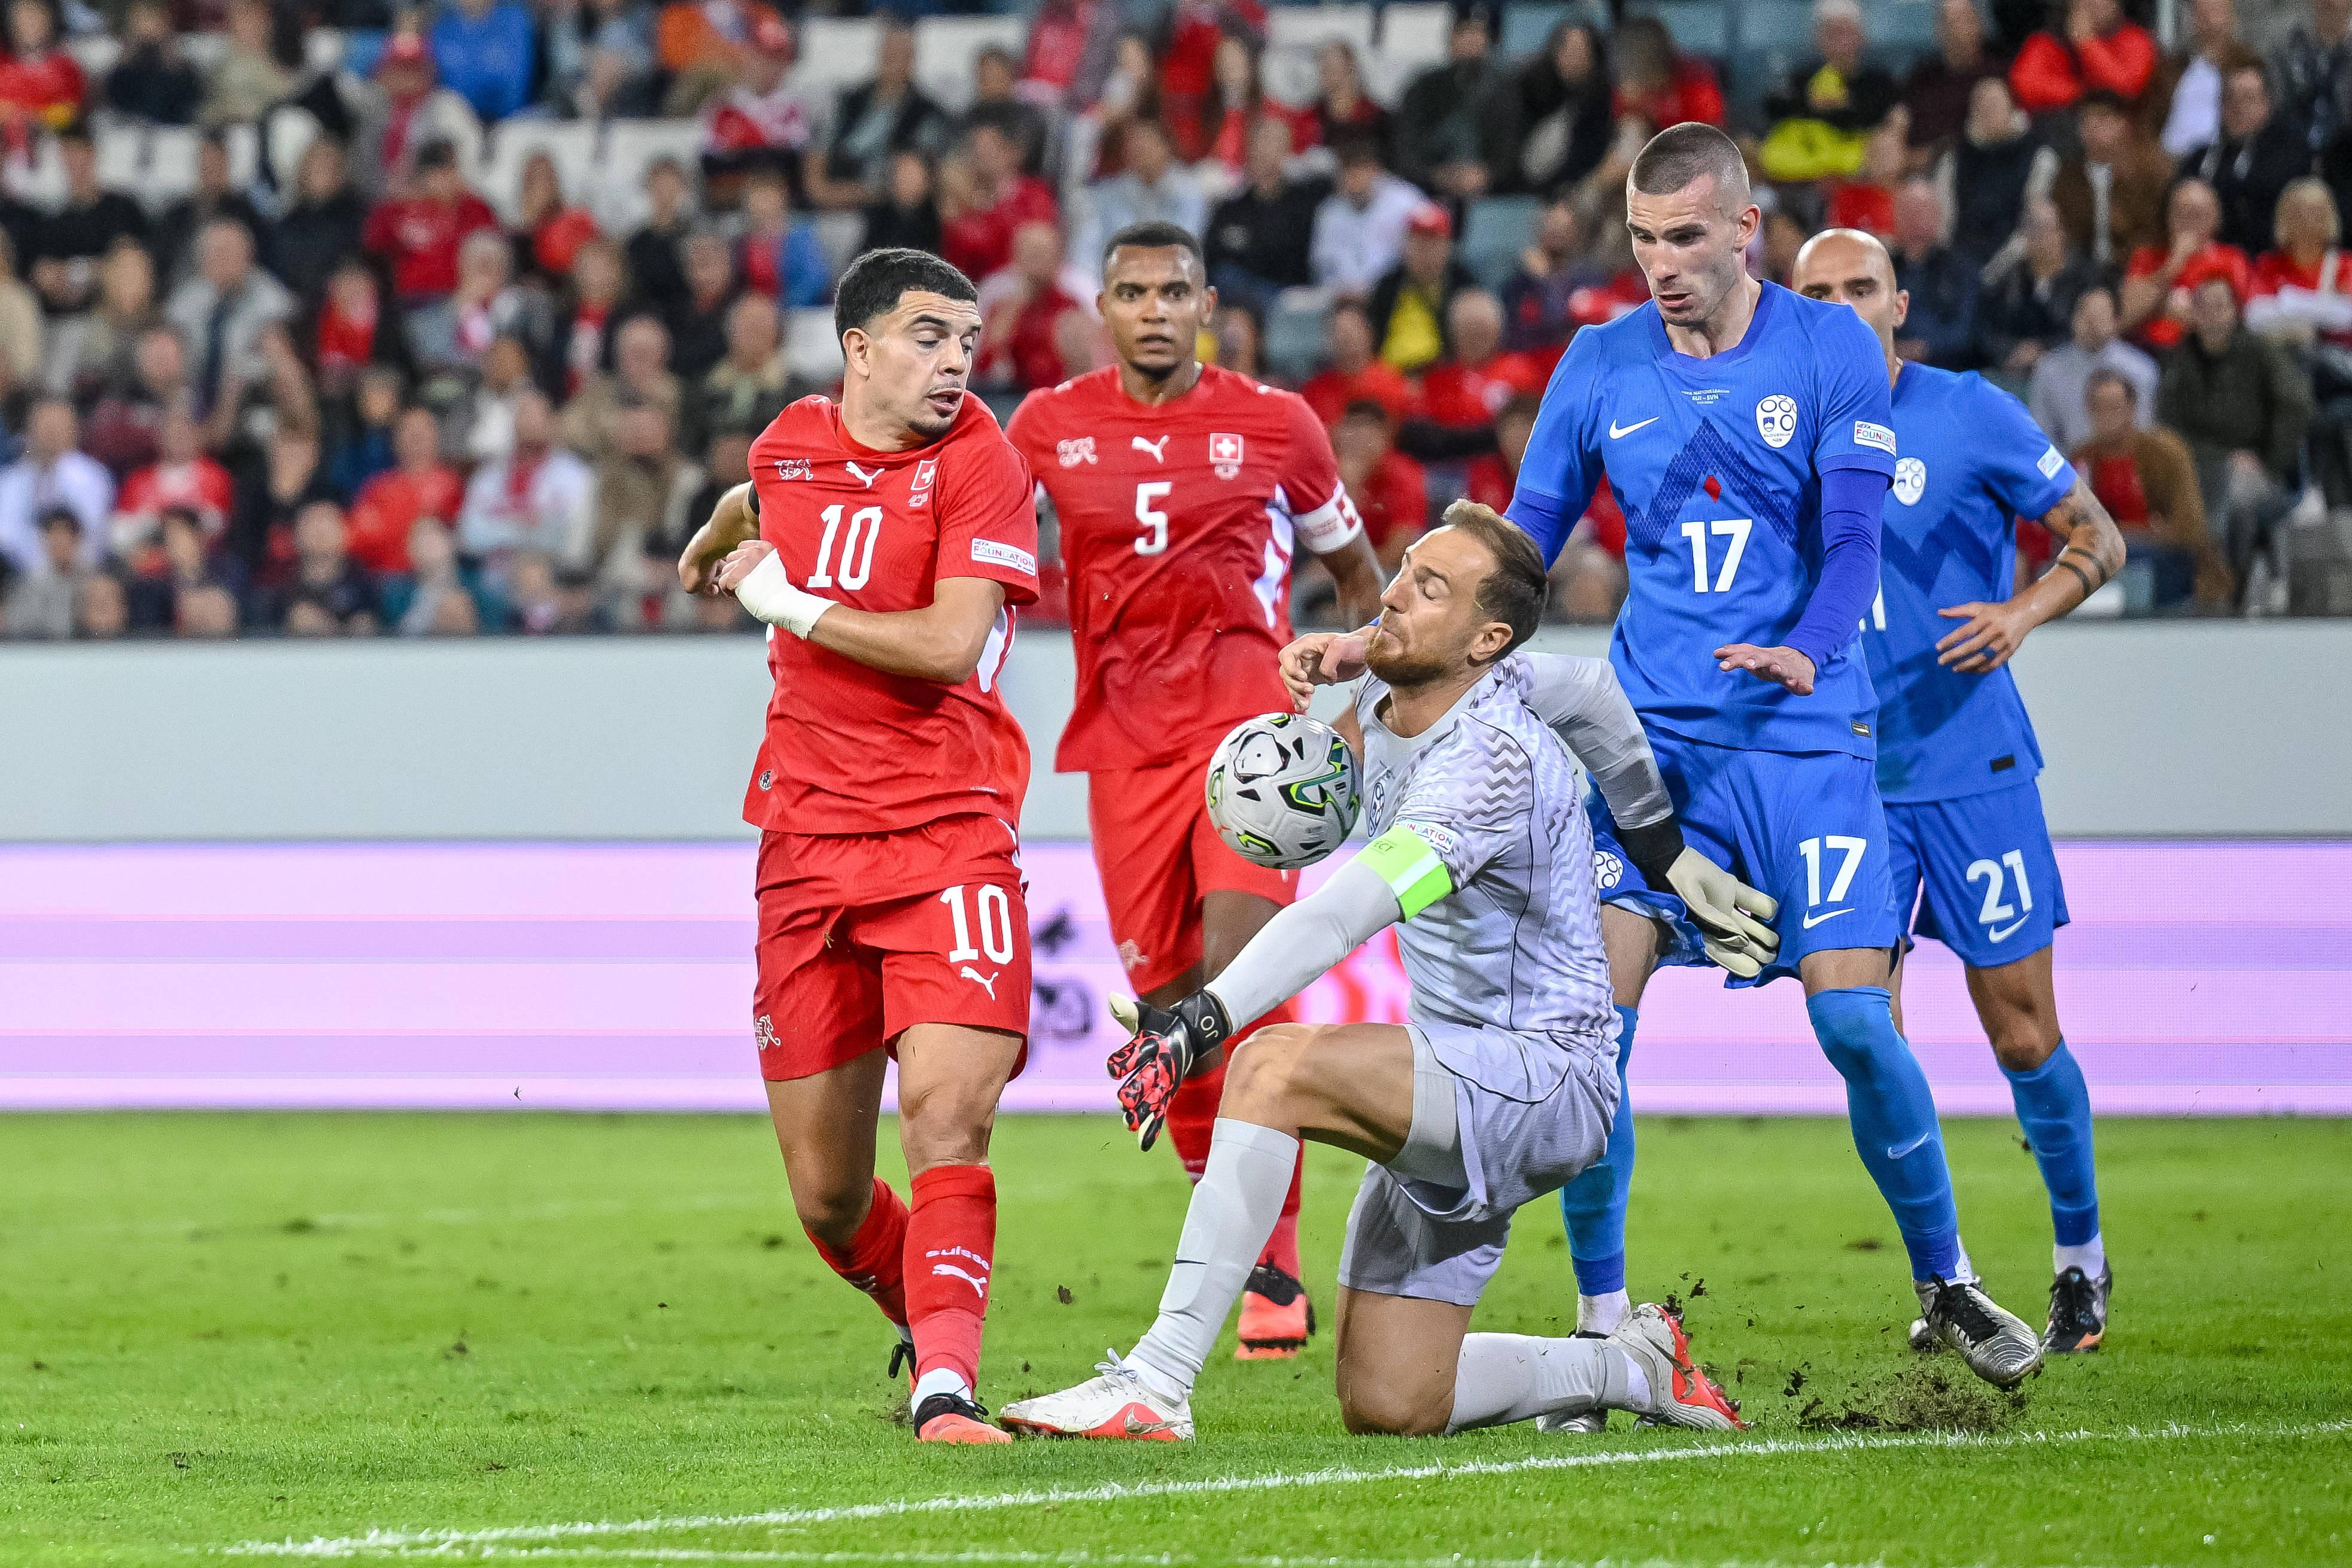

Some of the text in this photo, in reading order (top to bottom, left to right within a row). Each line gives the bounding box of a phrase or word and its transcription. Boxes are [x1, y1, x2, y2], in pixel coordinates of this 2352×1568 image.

[806, 504, 884, 591] 10
[1134, 481, 1172, 555] 5
[1681, 518, 1753, 592] 17
[974, 545, 1034, 569] FOUNDATION
[1396, 823, 1453, 846] NDATION
[1798, 835, 1867, 907] 17
[939, 883, 1014, 965] 10
[1966, 849, 2034, 925] 21
